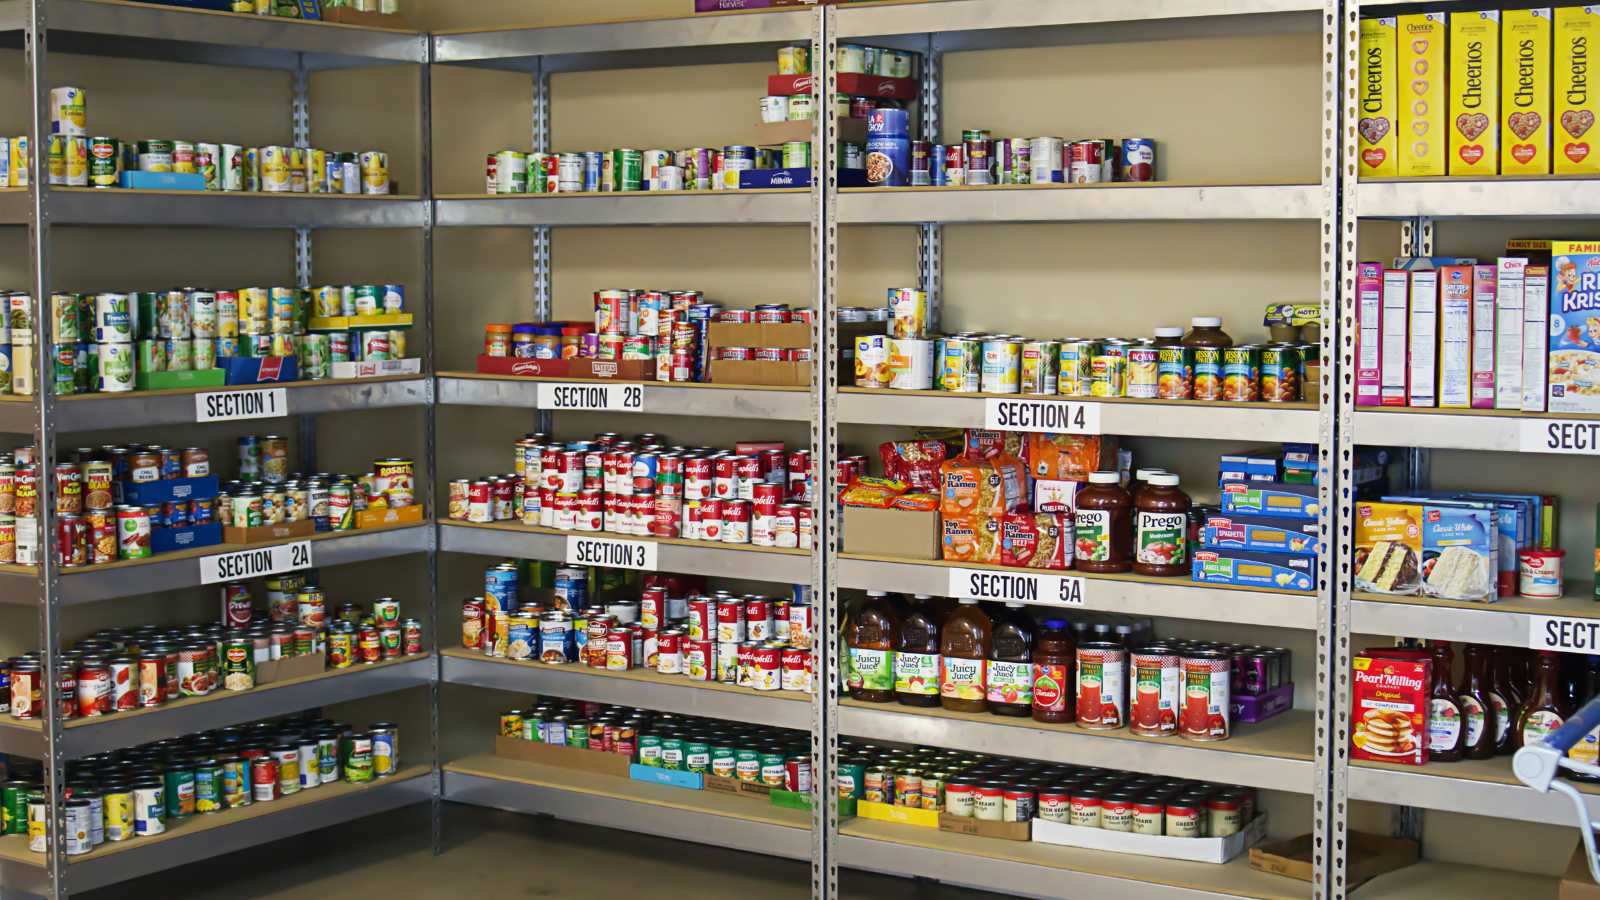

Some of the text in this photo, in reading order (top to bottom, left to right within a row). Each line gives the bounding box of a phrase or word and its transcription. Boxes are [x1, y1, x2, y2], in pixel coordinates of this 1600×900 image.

[1407, 24, 1433, 32] Cheerios
[1462, 41, 1482, 109] Cheerios
[1514, 39, 1534, 108] Cheerios
[1567, 36, 1587, 106] Cheerios
[1363, 47, 1382, 113] Cheerios
[868, 113, 875, 123] LA
[868, 123, 884, 131] CHOY
[771, 176, 793, 185] Millville
[1507, 241, 1531, 249] FAMILY
[986, 352, 999, 360] Dole
[1132, 353, 1156, 361] ROYAL
[554, 387, 641, 408] SECTION 2B
[207, 392, 275, 417] SECTION 1
[998, 402, 1085, 430] SECTION 4
[971, 431, 1001, 441] Ramen
[980, 439, 994, 447] BEEF
[946, 472, 963, 483] Top
[947, 481, 977, 490] Ramen
[1234, 496, 1249, 504] ANGEL
[1041, 504, 1069, 513] MUELLER'S
[944, 520, 959, 530] Top
[1142, 514, 1182, 531] Prego
[1363, 516, 1408, 528] Classic Yellow
[1004, 522, 1020, 533] Top
[1432, 523, 1473, 533] Classic White
[945, 528, 974, 538] Ramen
[1005, 530, 1035, 540] Ramen
[1218, 530, 1244, 538] SPAGHETTI
[1012, 539, 1028, 547] BEEF
[577, 541, 645, 567] SECTION 3
[218, 544, 309, 580] SECTION 2A
[1205, 563, 1219, 571] ANGEL
[970, 573, 1081, 603] SECTION 5A
[856, 655, 881, 665] Juicy
[899, 654, 921, 665] Juicy
[901, 662, 919, 671] Juice
[950, 664, 977, 676] Juicy
[992, 663, 1016, 675] Juicy
[951, 672, 974, 680] Juice
[994, 670, 1014, 679] Juice
[1355, 670, 1422, 691] Pearl Milling
[1036, 688, 1057, 698] Tomato
[1376, 690, 1402, 699] Original
